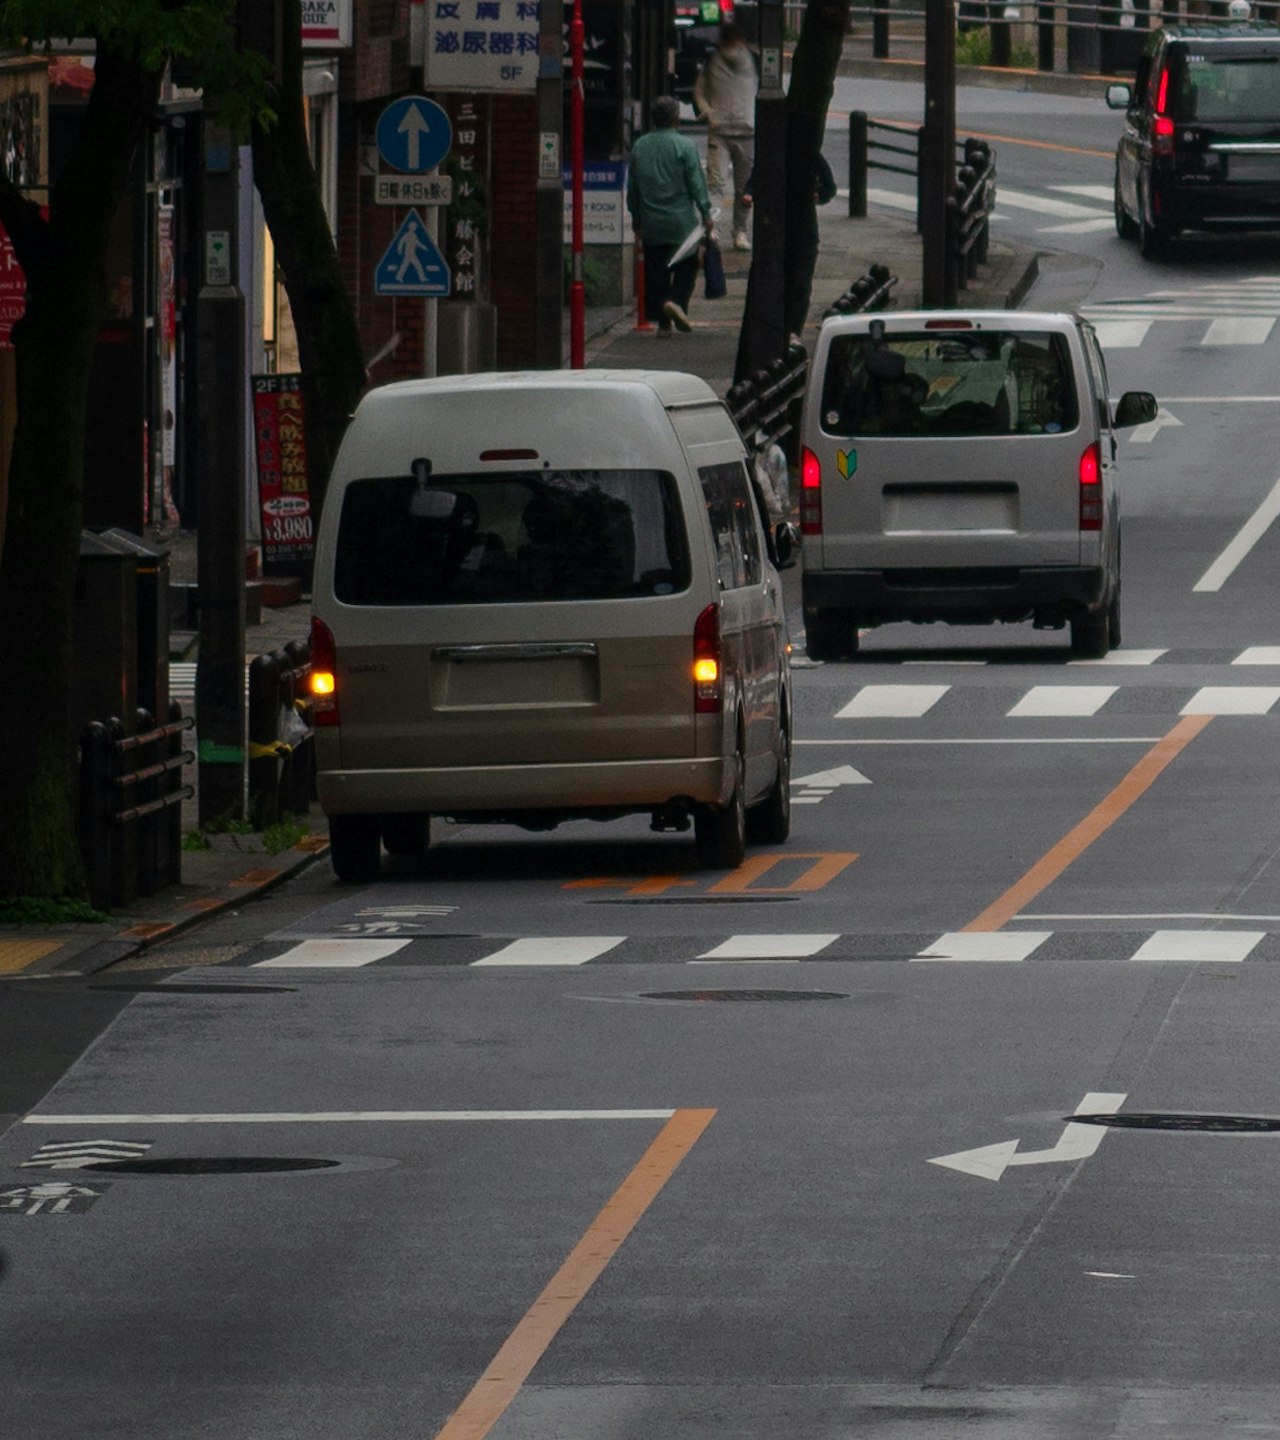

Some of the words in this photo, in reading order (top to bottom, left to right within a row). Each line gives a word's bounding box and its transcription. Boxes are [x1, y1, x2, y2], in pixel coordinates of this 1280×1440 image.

[434, 31, 541, 55] 泌尿器科
[500, 66, 523, 80] 5F
[256, 379, 278, 393] 2F
